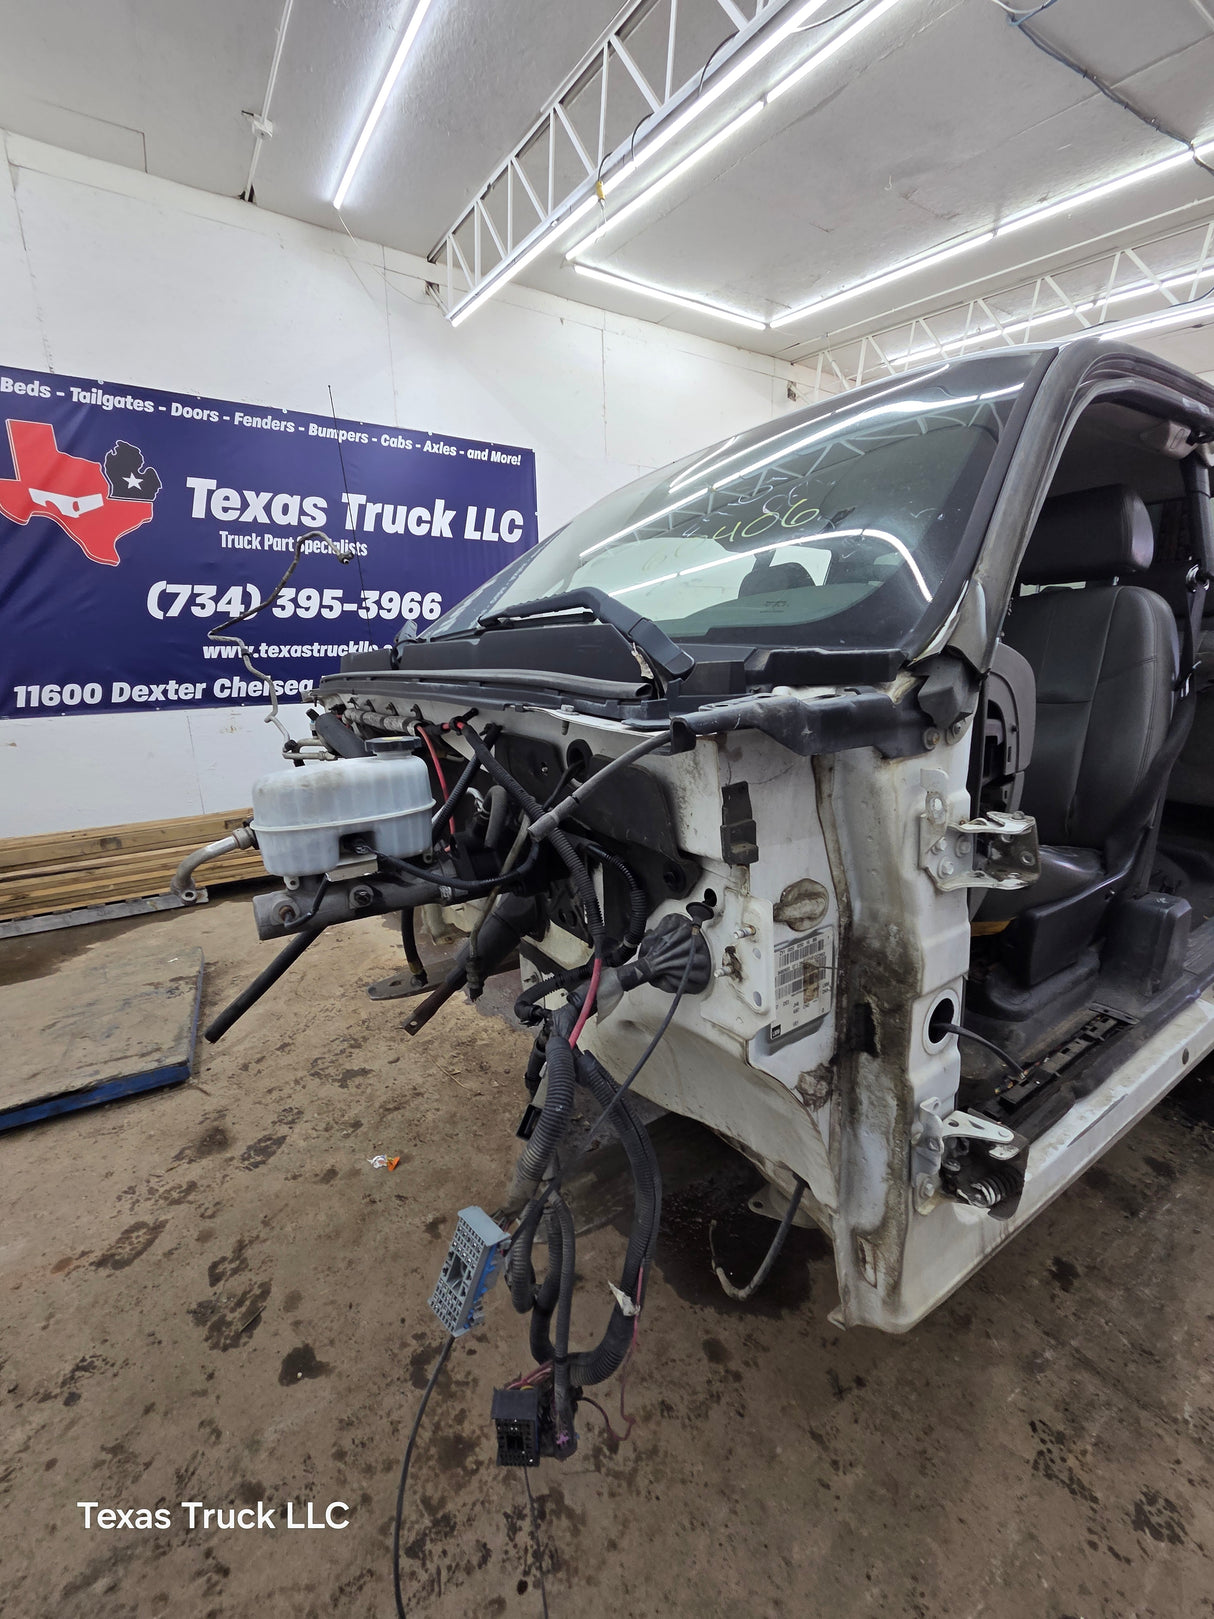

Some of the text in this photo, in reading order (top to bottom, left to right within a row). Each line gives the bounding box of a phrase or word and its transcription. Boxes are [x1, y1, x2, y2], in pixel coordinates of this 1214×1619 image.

[0, 377, 51, 398] Beds
[69, 387, 155, 413] Tailgates
[171, 402, 220, 421] Doors
[234, 412, 296, 433] Fenders
[308, 423, 369, 444] Bumpers
[381, 434, 414, 450] Cabs
[423, 441, 458, 457] Axles
[466, 449, 489, 461] and
[490, 451, 522, 466] More!
[186, 477, 524, 543] Texas Truck LLC
[219, 531, 262, 552] Truck
[264, 534, 295, 552] Part
[147, 580, 443, 620] (734) 395-3966
[13, 675, 314, 708] 11600 Dexter Chelsea
